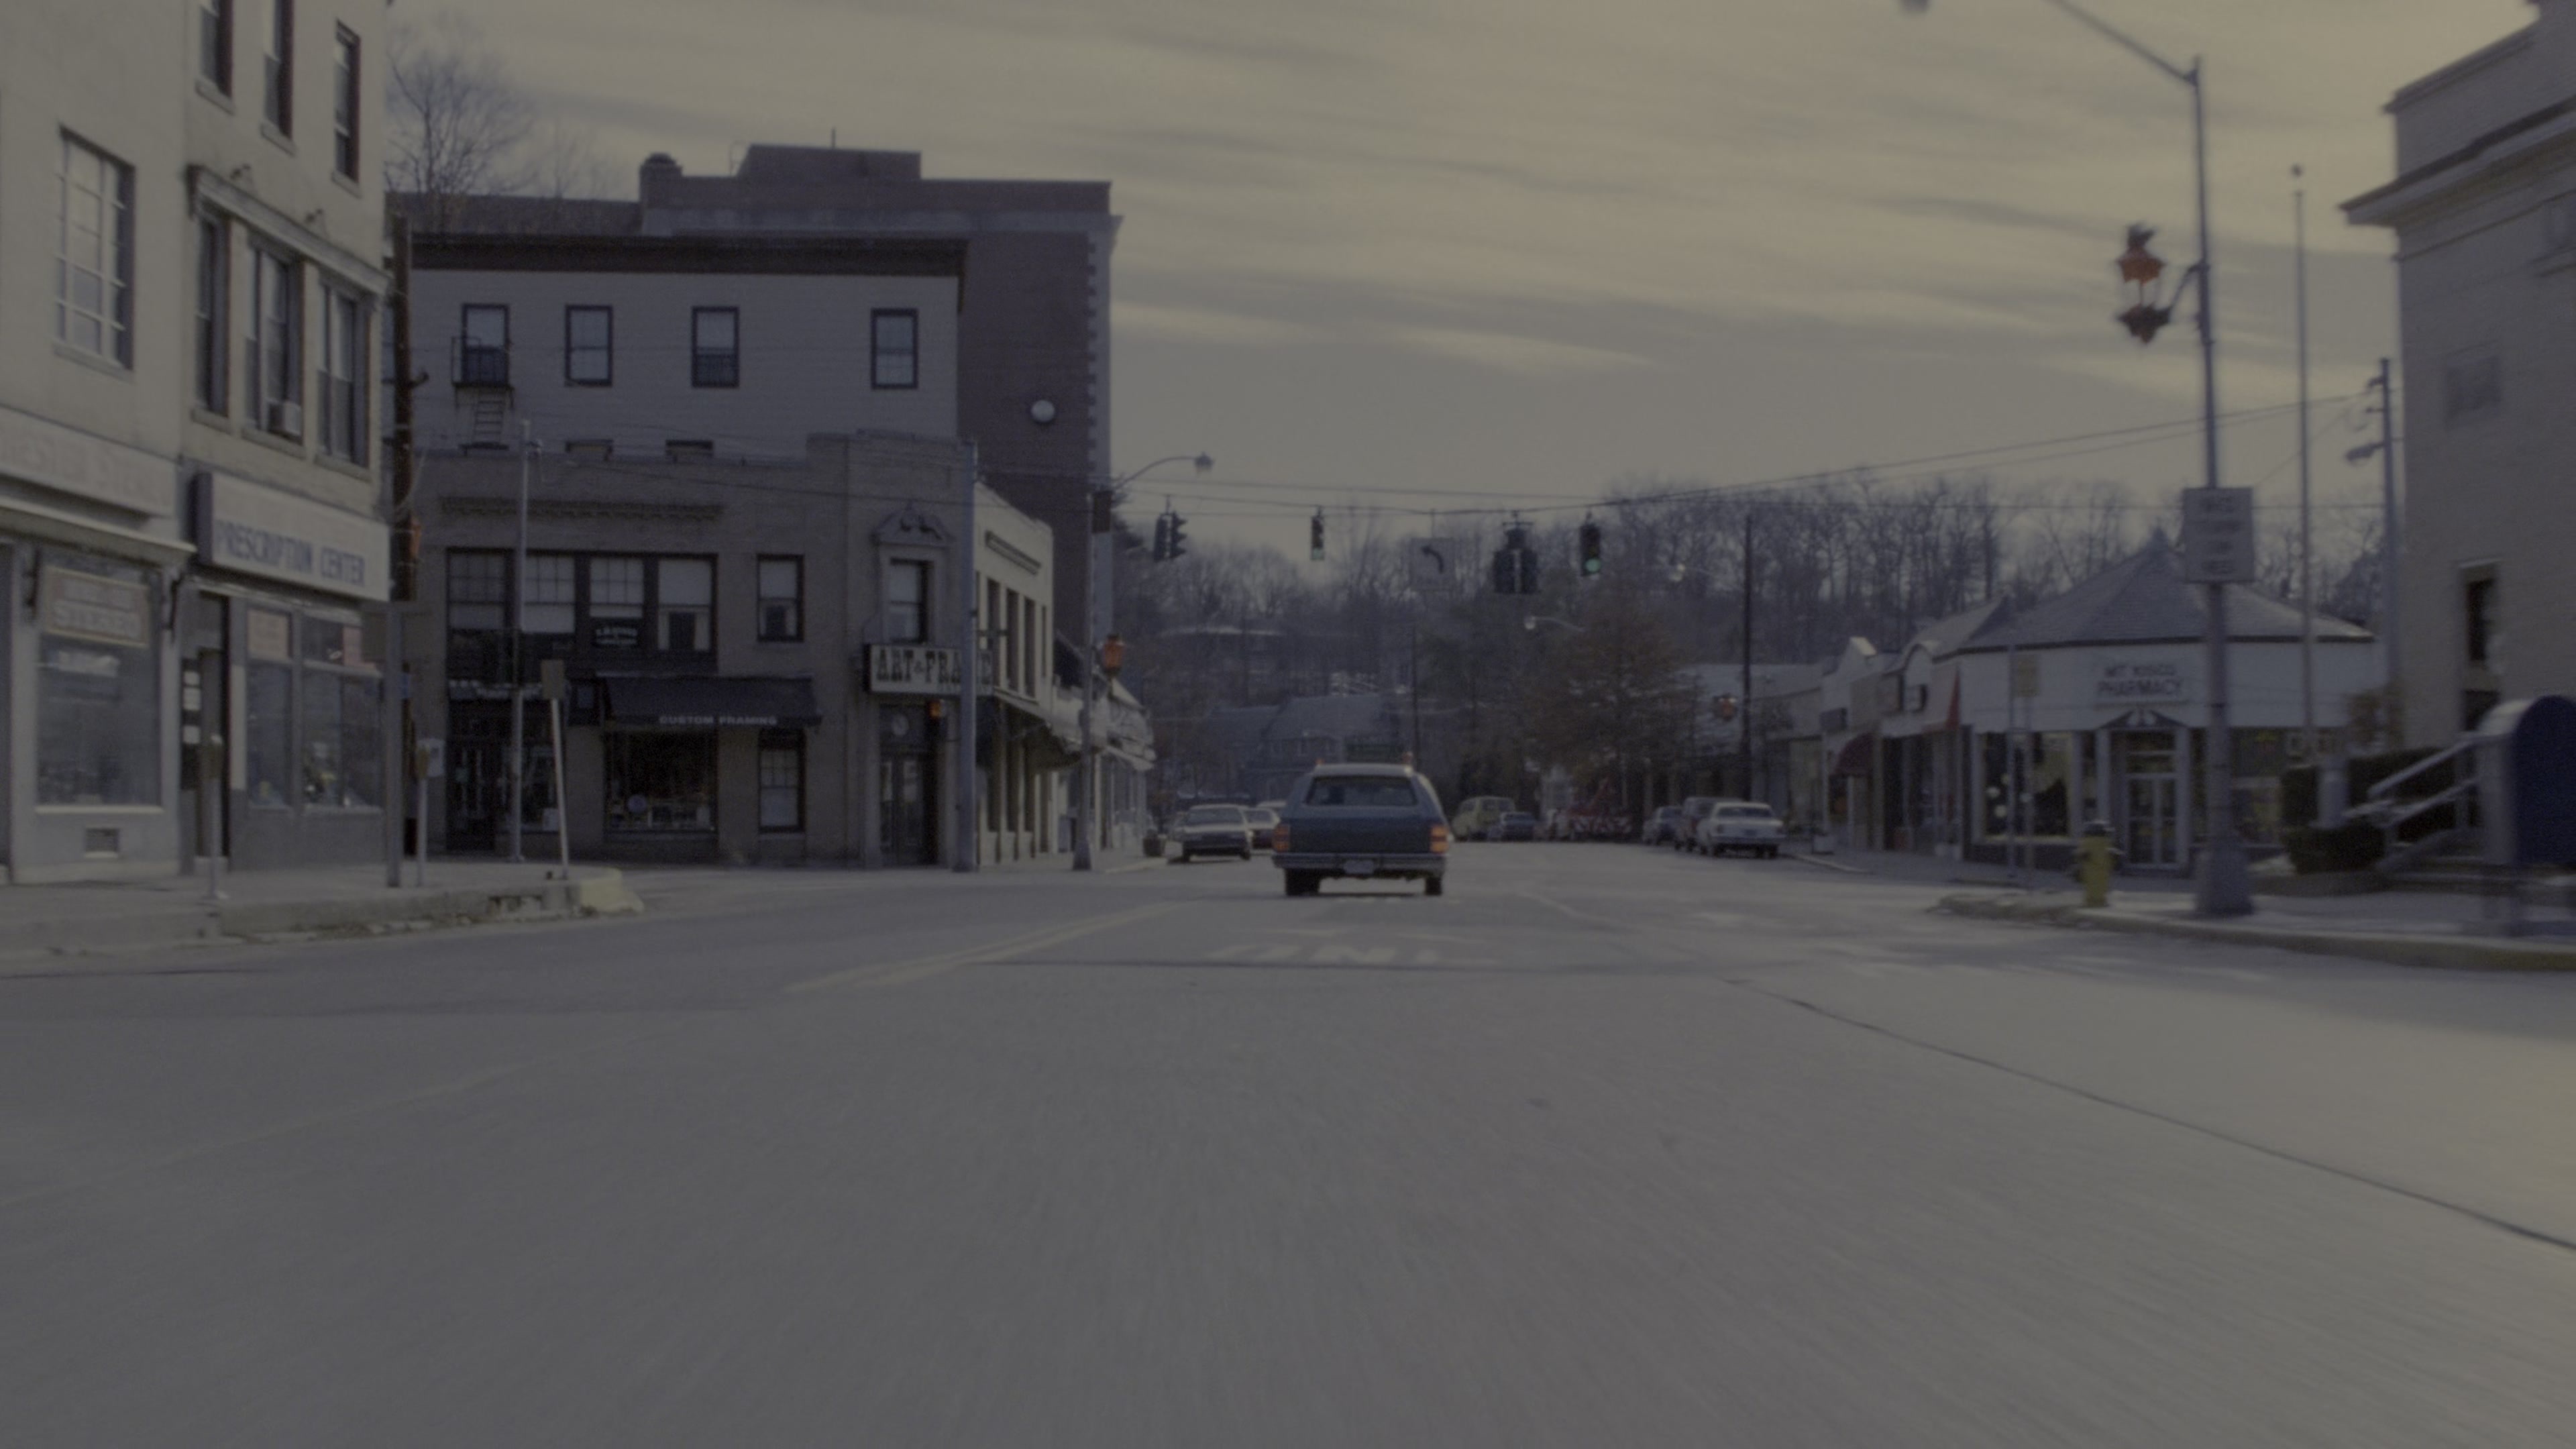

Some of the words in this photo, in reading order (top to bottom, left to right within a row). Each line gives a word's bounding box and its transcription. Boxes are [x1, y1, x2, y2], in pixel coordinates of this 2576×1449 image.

[215, 519, 313, 574] PRESCRIPTION
[320, 545, 364, 587] CENTER
[877, 649, 913, 682] ART
[914, 661, 924, 674] &
[926, 651, 989, 684] FRAE
[2097, 679, 2184, 696] PHARMACY
[659, 714, 714, 725] CUSTOM
[718, 714, 777, 726] FRAMING
